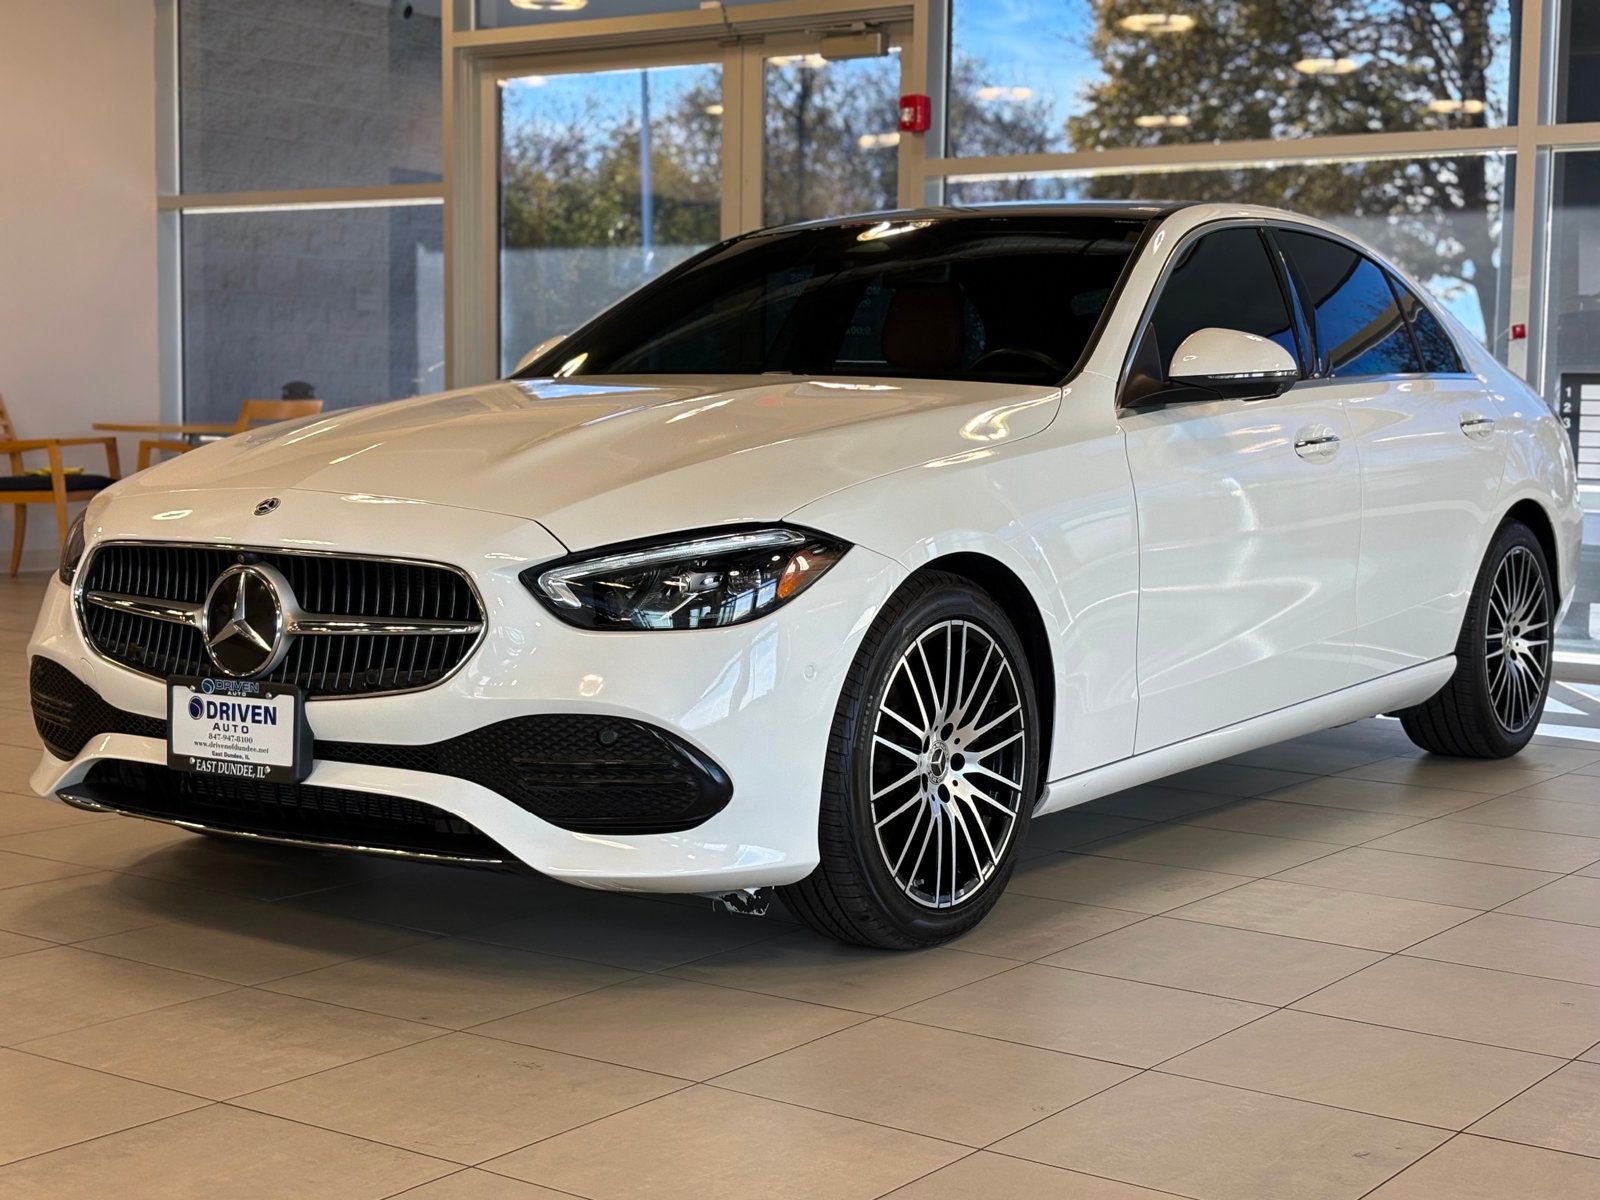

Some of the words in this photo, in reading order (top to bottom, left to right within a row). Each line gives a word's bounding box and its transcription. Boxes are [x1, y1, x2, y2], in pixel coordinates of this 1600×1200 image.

[1565, 387, 1571, 397] 1
[1563, 402, 1571, 413] 2
[1563, 417, 1571, 429] 3
[215, 679, 259, 693] DRIVEN
[206, 700, 277, 725] DRIVEN
[213, 722, 249, 734] AUTO
[208, 733, 253, 743] 847-947-8100
[194, 741, 269, 754] www.drivenofdundee.net
[196, 759, 217, 773] EAST
[217, 761, 255, 779] DUNDEE,
[256, 766, 265, 778] IL
